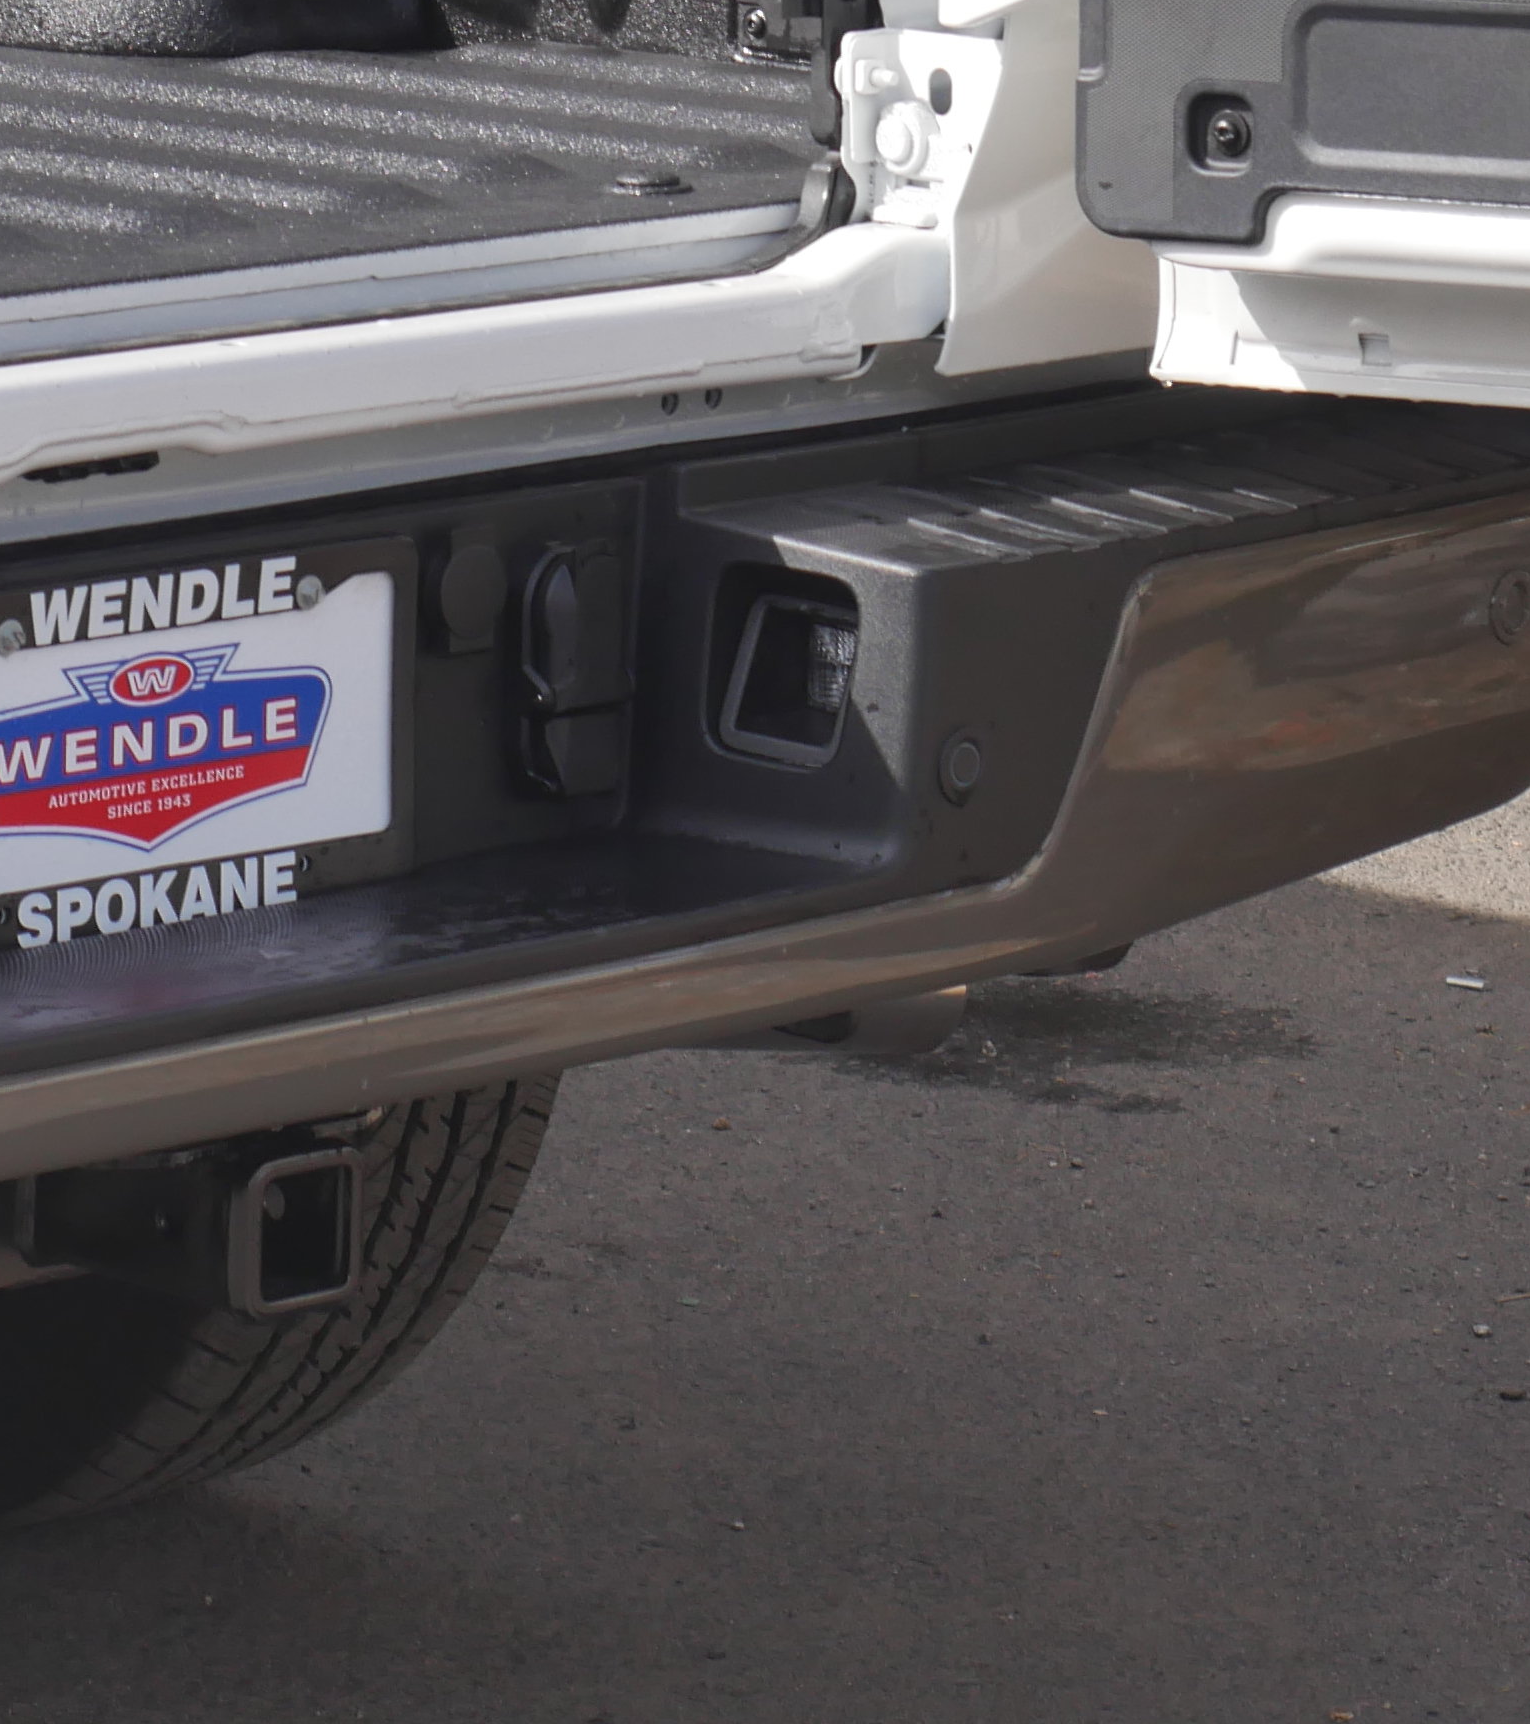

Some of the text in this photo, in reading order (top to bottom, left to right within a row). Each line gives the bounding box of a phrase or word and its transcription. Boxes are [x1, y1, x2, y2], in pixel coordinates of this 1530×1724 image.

[30, 556, 298, 646] WENDLE
[48, 765, 245, 810] AUTOMOTIVE EXCELLENCE
[107, 793, 192, 820] SINCE 1943
[16, 850, 298, 950] SPOKANE
